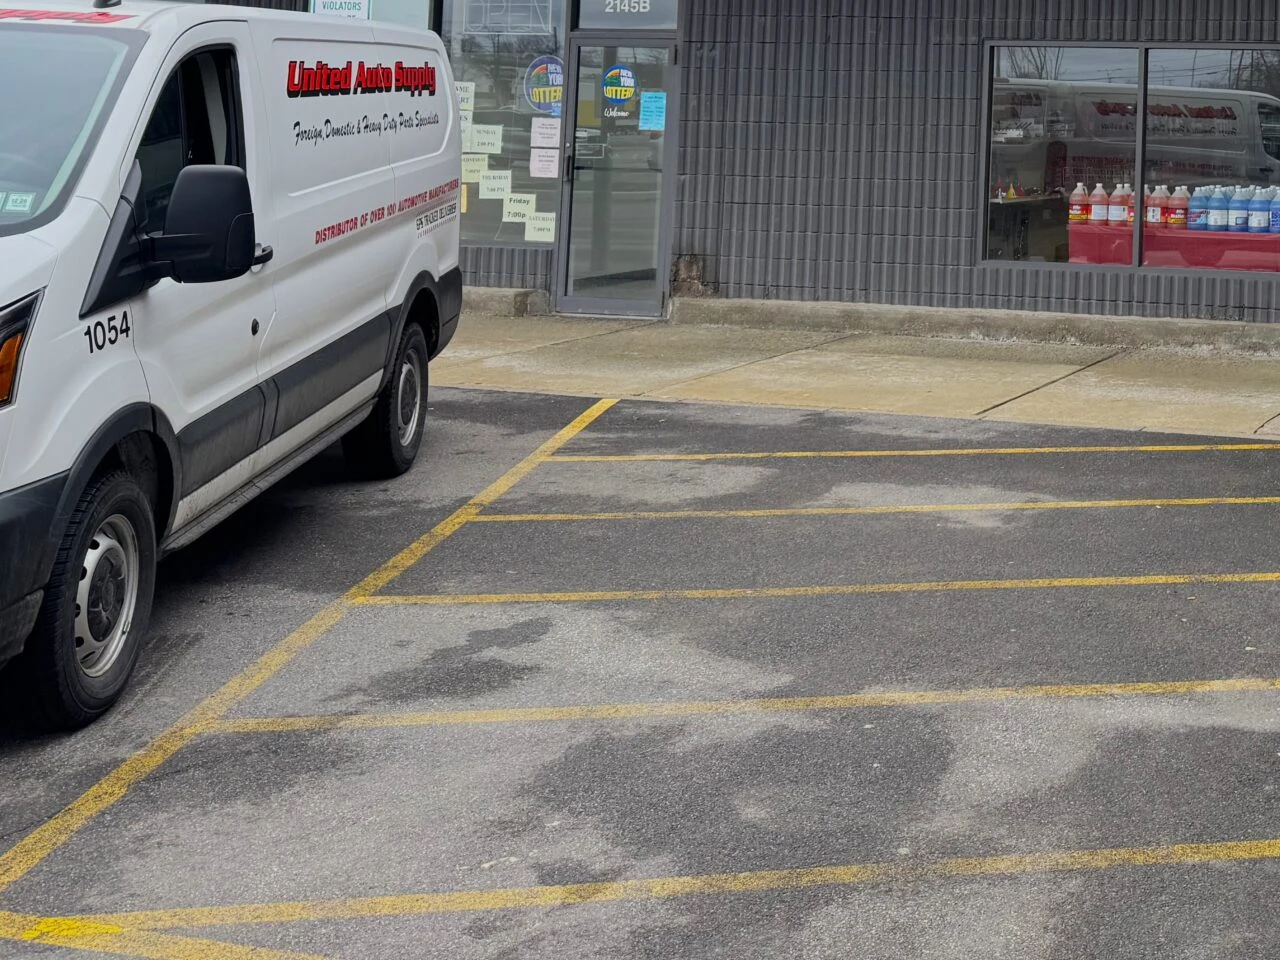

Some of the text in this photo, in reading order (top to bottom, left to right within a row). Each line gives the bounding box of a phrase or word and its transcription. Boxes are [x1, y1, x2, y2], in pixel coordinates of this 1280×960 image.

[322, 1, 362, 11] VIOLATORS
[287, 60, 436, 98] United Auto Supply
[548, 73, 563, 86] YOR
[529, 85, 563, 103] LOTTER
[603, 86, 635, 100] LOTTERY
[603, 106, 630, 118] Welcome
[362, 114, 382, 136] Heavy
[383, 113, 398, 135] Duty
[509, 197, 531, 206] Friday
[315, 216, 359, 245] DISTRIBUTOR
[360, 212, 369, 228] OF
[370, 206, 385, 224] OVER
[397, 191, 428, 213] AUTOMOTIVE
[84, 310, 131, 354] 1054
